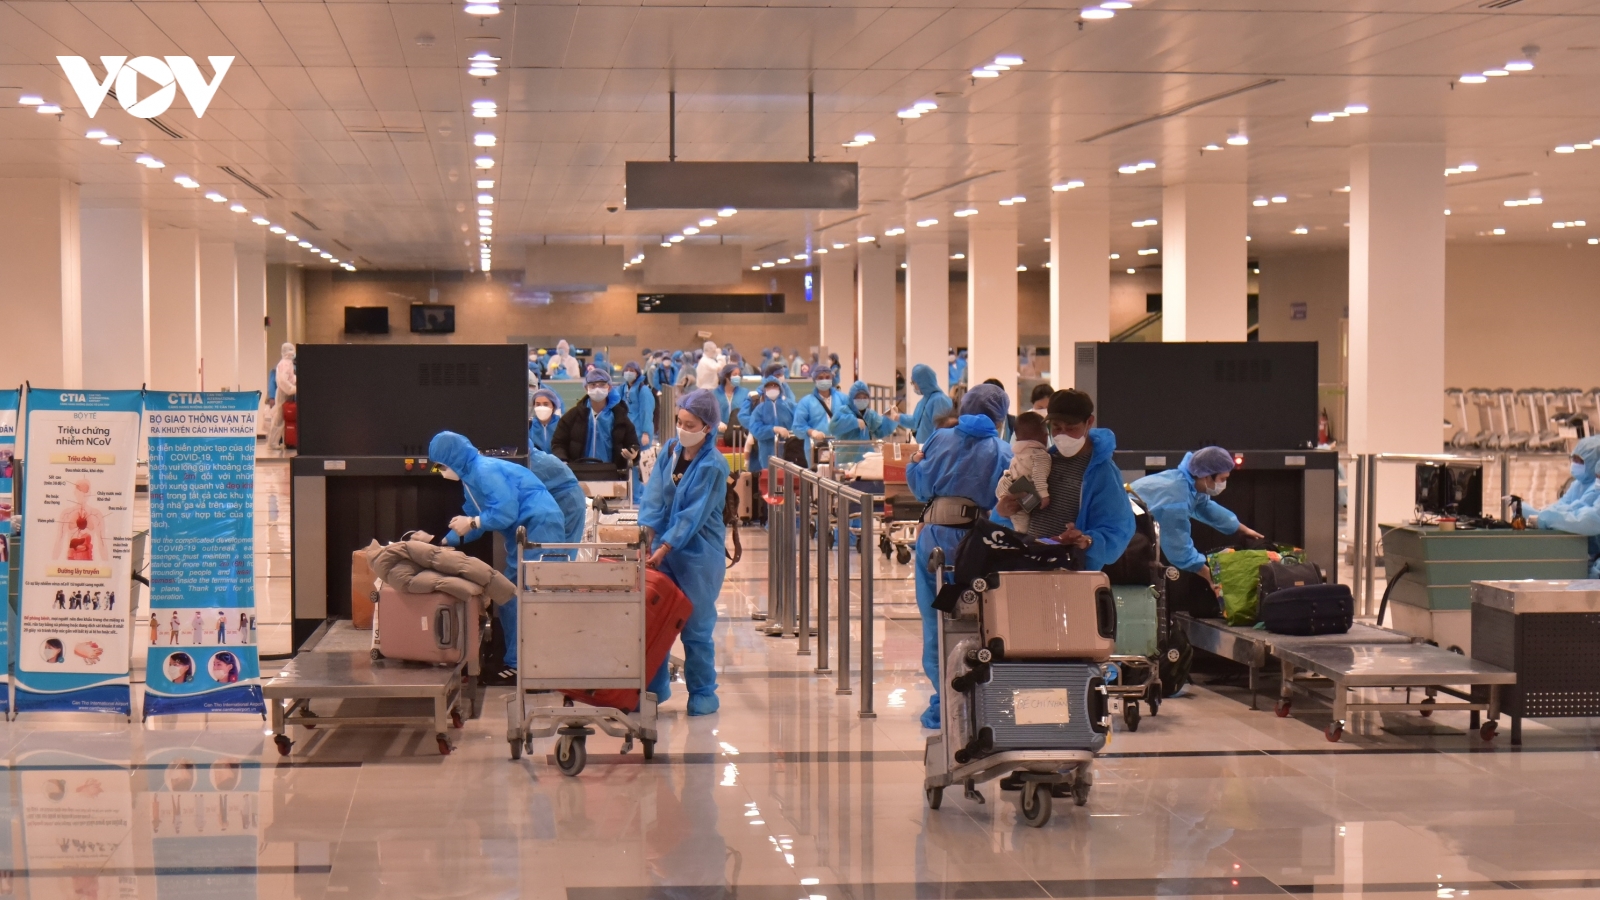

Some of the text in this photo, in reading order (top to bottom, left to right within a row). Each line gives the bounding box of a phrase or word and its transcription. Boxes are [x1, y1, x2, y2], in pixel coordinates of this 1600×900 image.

[60, 393, 86, 403] CTIA
[168, 393, 204, 405] CTIA
[149, 413, 254, 425] BỘ GIAO THÔNG VẬN TẢI
[58, 426, 110, 437] Triệu chứng
[192, 425, 207, 434] CÁO
[230, 425, 254, 434] KHÁCH
[56, 436, 112, 446] nhiễm NCoV
[149, 454, 163, 462] ệnh
[150, 483, 167, 491] gười
